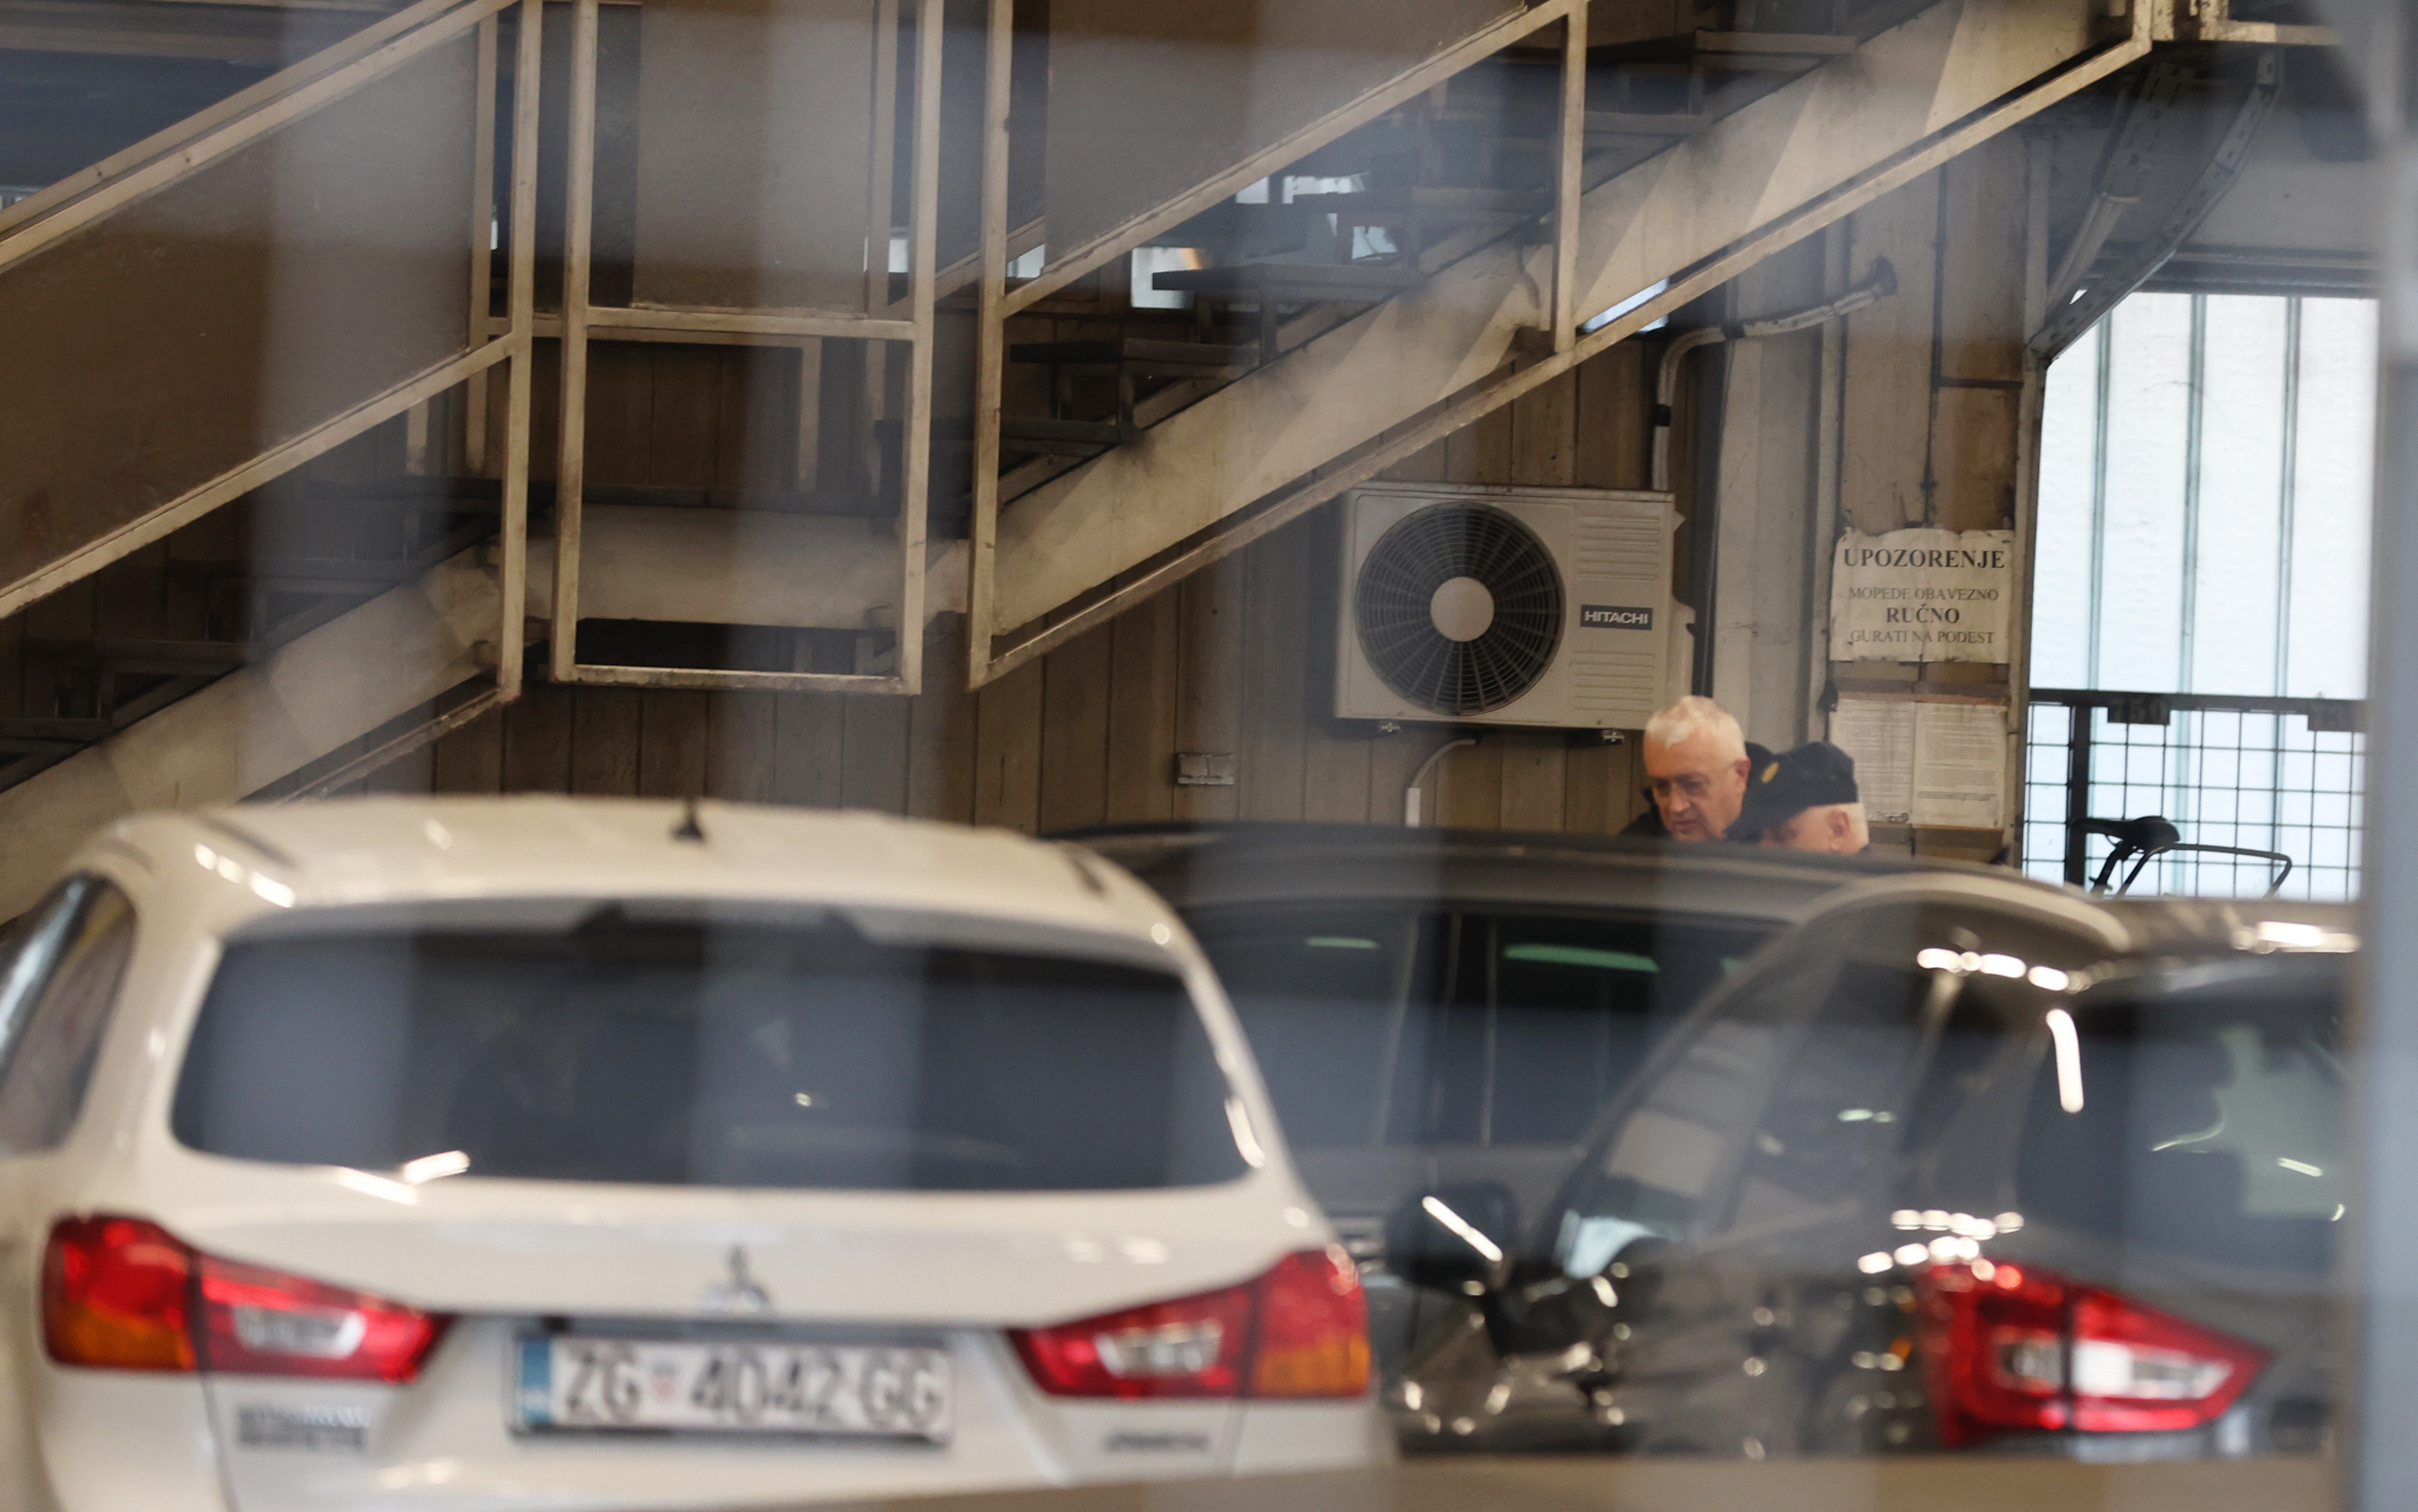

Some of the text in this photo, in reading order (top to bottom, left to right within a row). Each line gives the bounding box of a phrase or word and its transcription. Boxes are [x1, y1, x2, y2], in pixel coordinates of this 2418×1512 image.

[1844, 548, 2005, 568] UPOZORENJE
[1848, 587, 1999, 601] MOPEDE OBAVEZNO
[1584, 610, 1649, 625] HITACHI
[1850, 630, 1995, 644] GURATI NA PODEST
[563, 1338, 945, 1433] ZG 4042 GG
